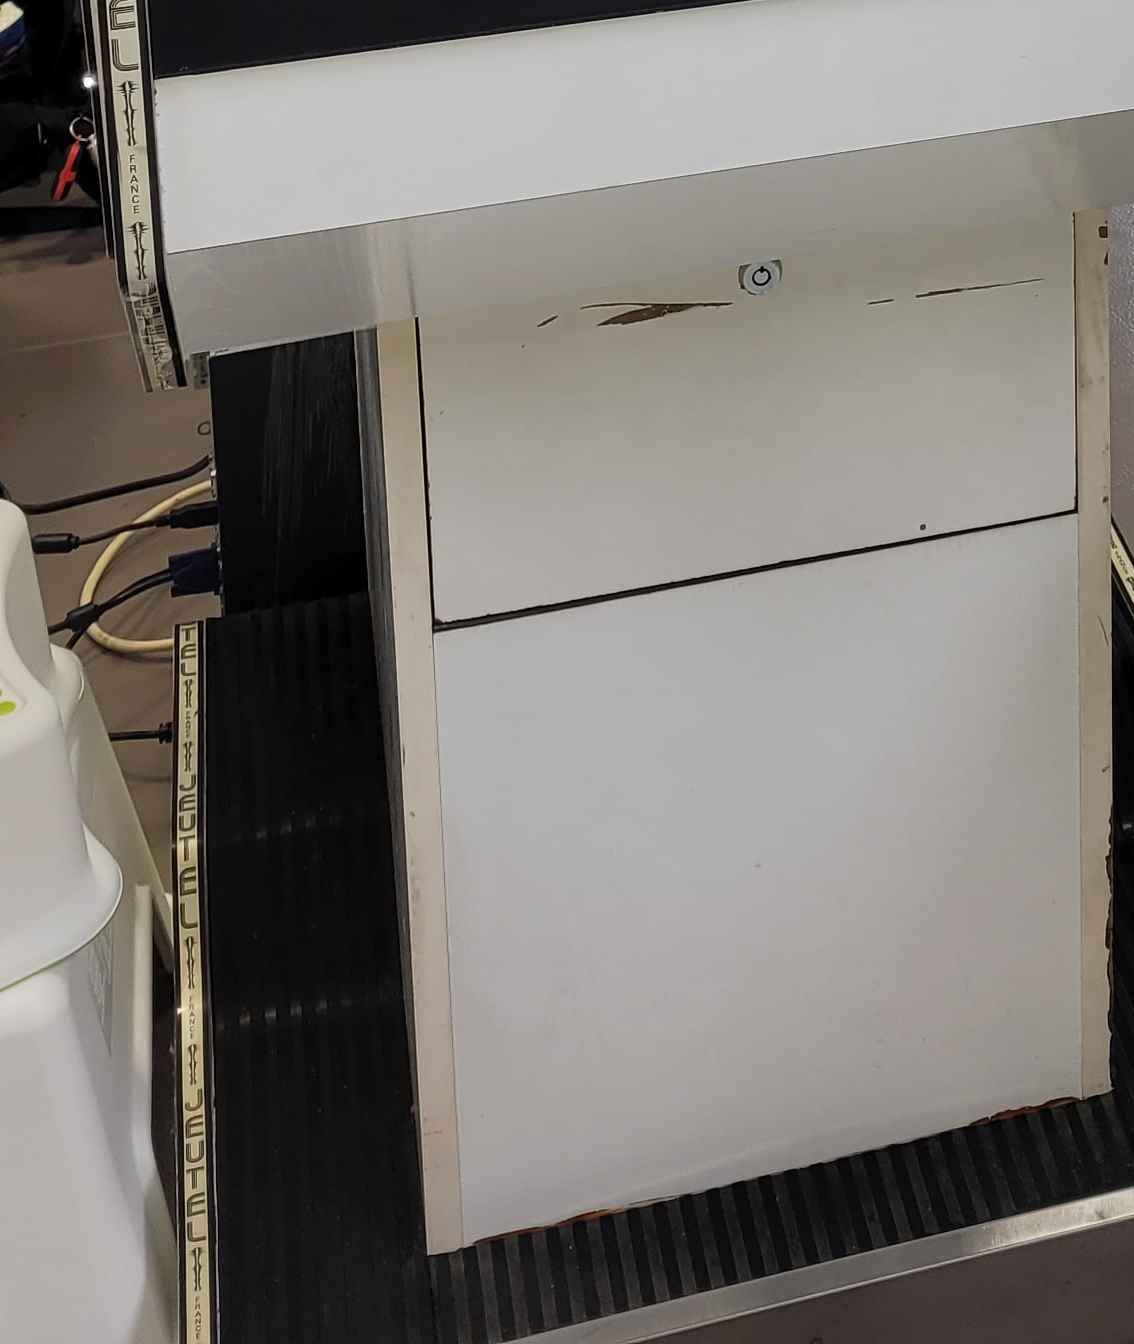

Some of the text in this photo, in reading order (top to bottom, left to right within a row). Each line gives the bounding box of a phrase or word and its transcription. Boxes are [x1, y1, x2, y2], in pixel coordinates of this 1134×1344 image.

[128, 153, 141, 216] FRANCE
[178, 774, 198, 929] JEUTEL
[184, 1088, 206, 1243] JEUTEL
